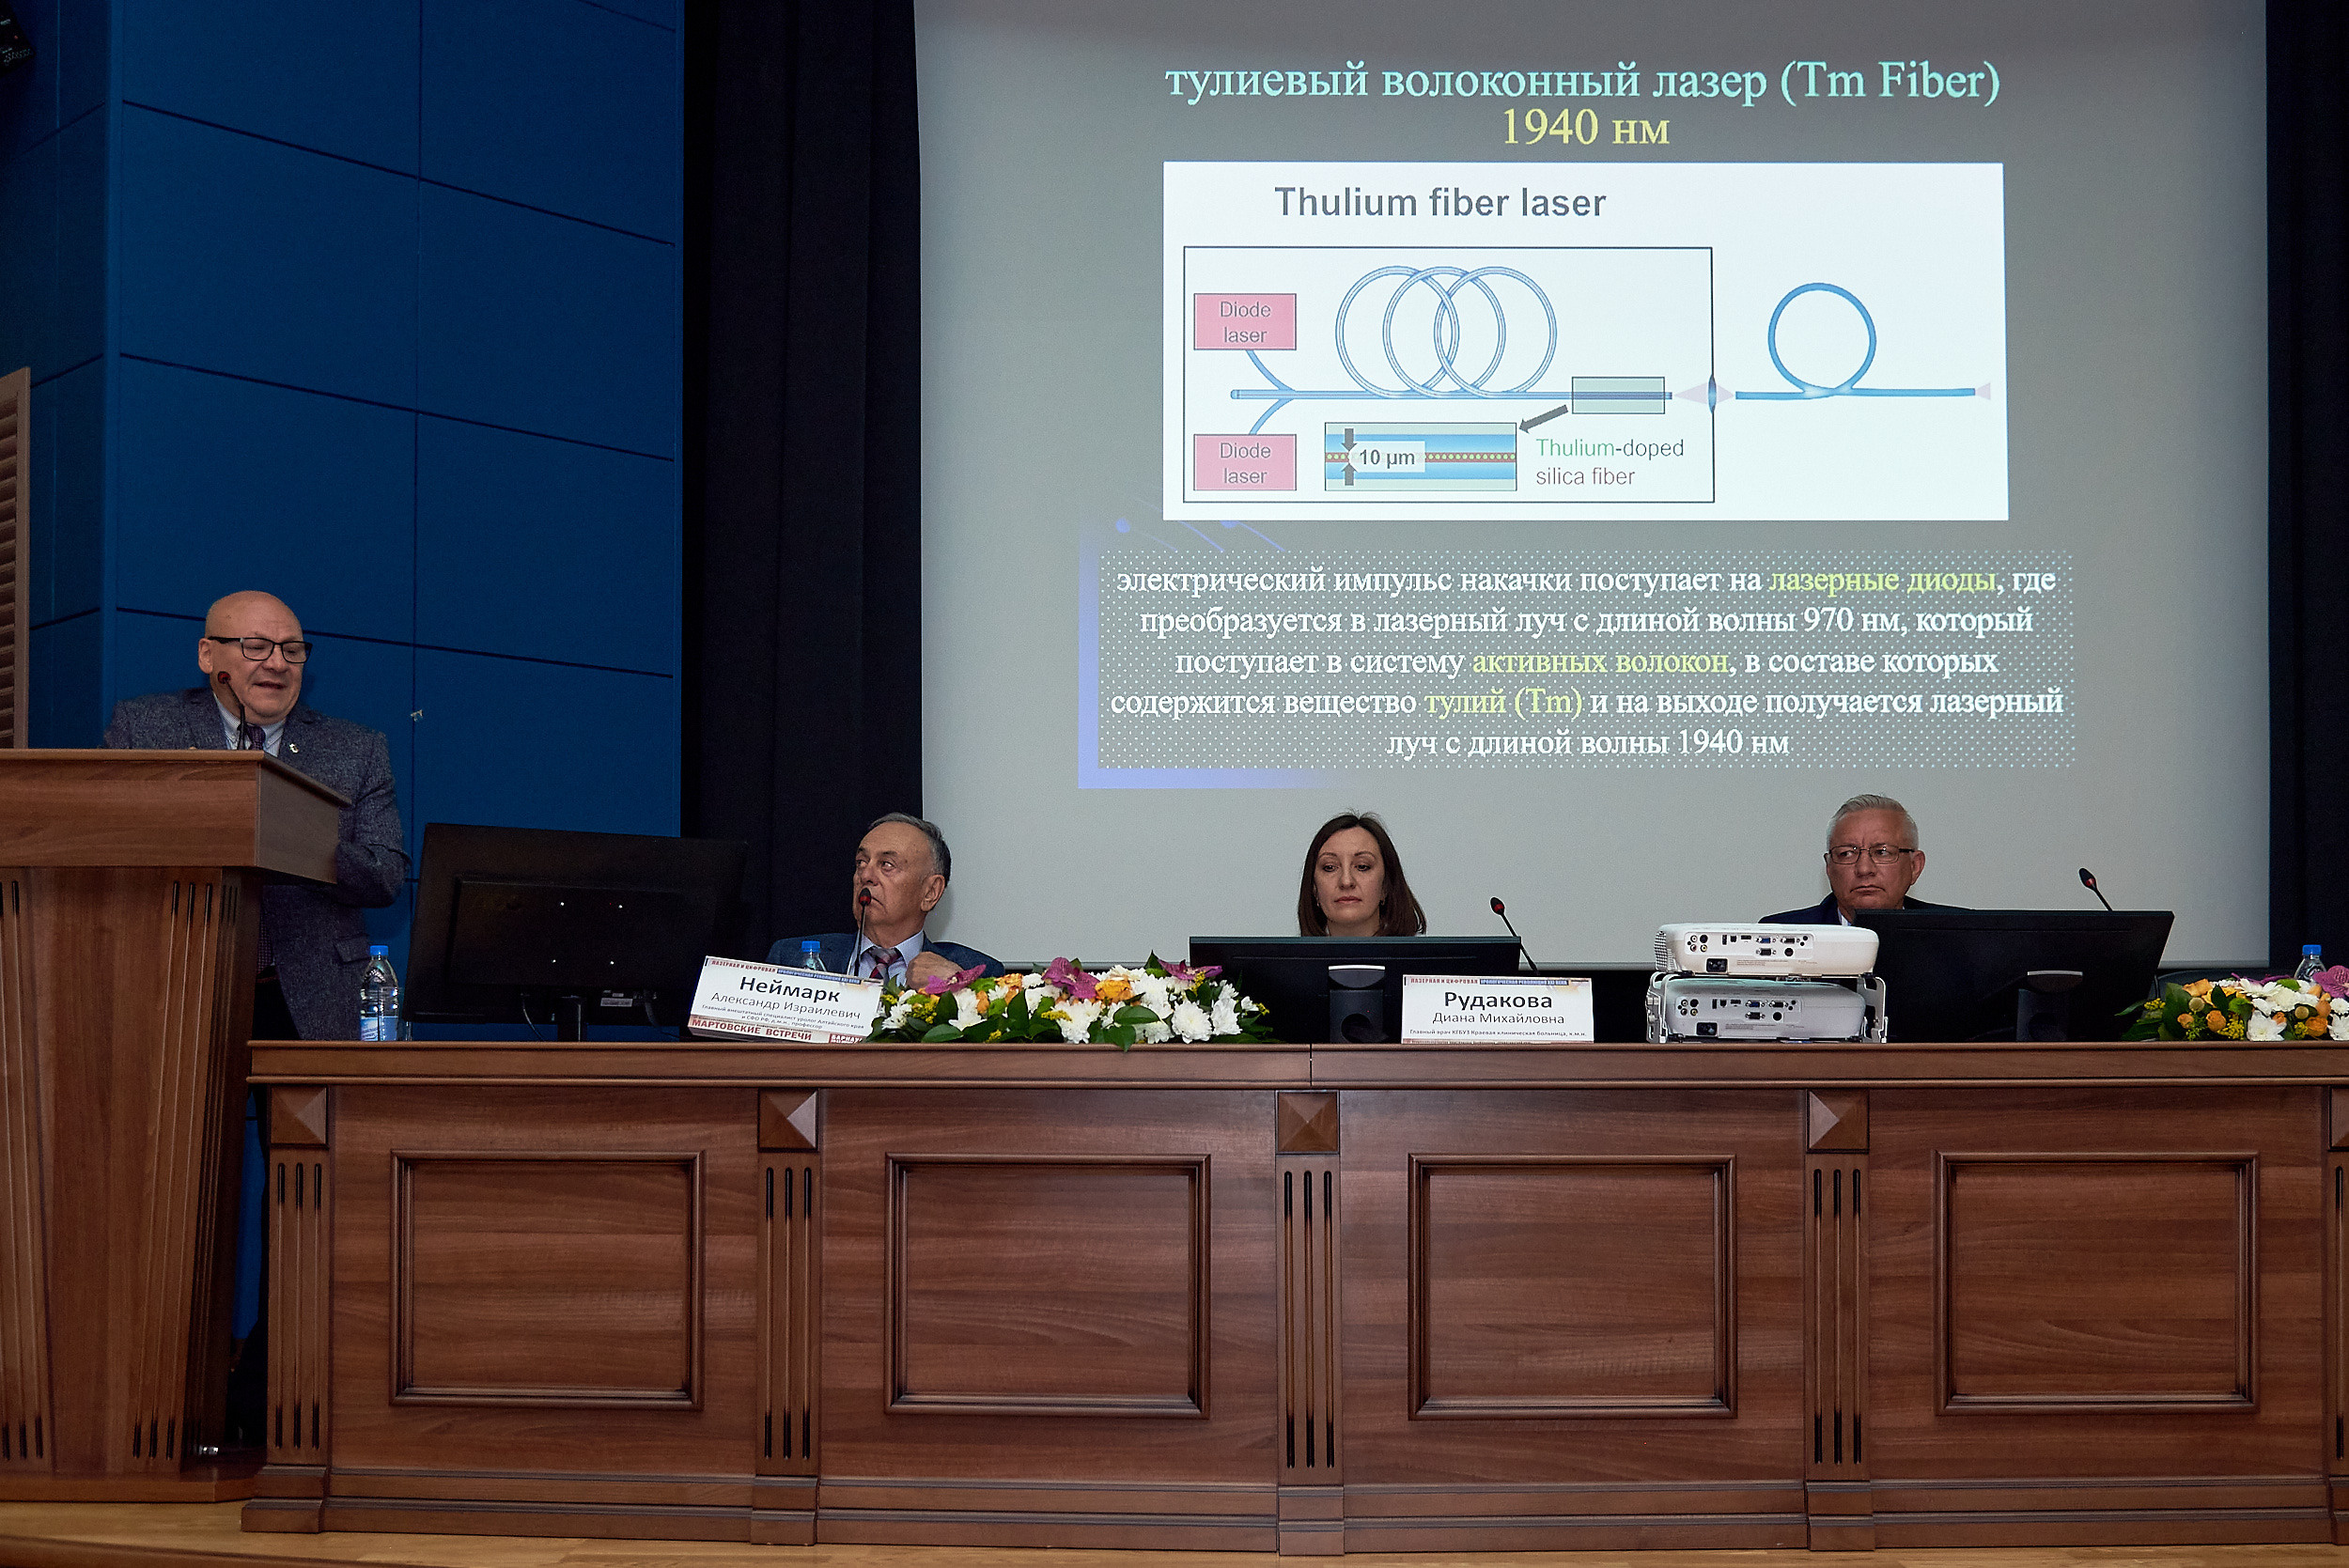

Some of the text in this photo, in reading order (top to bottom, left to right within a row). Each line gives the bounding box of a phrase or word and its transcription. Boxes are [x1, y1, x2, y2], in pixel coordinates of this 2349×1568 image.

[1165, 60, 2000, 107] тулиевый волоконный лазер (Tm Fiber)
[1503, 108, 1671, 145] 1940 нм
[1274, 187, 1607, 217] Thulium fiber laser
[1221, 301, 1271, 318] Diode
[1223, 326, 1268, 343] laser
[1221, 442, 1271, 458] Diode
[1360, 449, 1380, 465] 10
[1536, 438, 1684, 460] Thulium-doped
[1223, 467, 1268, 484] laser
[1536, 468, 1636, 485] silica fiber
[1117, 565, 2056, 598] электрический импульс накачки поступает на лазерные диоды, где
[1140, 606, 2033, 639] преобразуется в лазерный луч с длиной волны 970 нм, который
[1174, 654, 1999, 679] поступает в систему активных волокон, в составе которых
[1111, 686, 2063, 721] содержится вещество тулий (Tm) и на выходе получается лазерный
[1386, 728, 1790, 761] луч с длиной волны 1940 нм
[745, 965, 776, 973] ЦИФРОВАЯ
[739, 976, 841, 1002] Неймарк
[711, 992, 861, 1019] Александр Израилевич
[1444, 991, 1552, 1011] Рудакова
[763, 1013, 796, 1021] специалист
[817, 1019, 849, 1028] Алтайского
[791, 1021, 823, 1030] профессор
[1432, 1012, 1564, 1024] Диана Михайловна
[692, 1019, 762, 1034] МАРТОВСКИЕ
[766, 1028, 812, 1040] ВСТРЕЧИ
